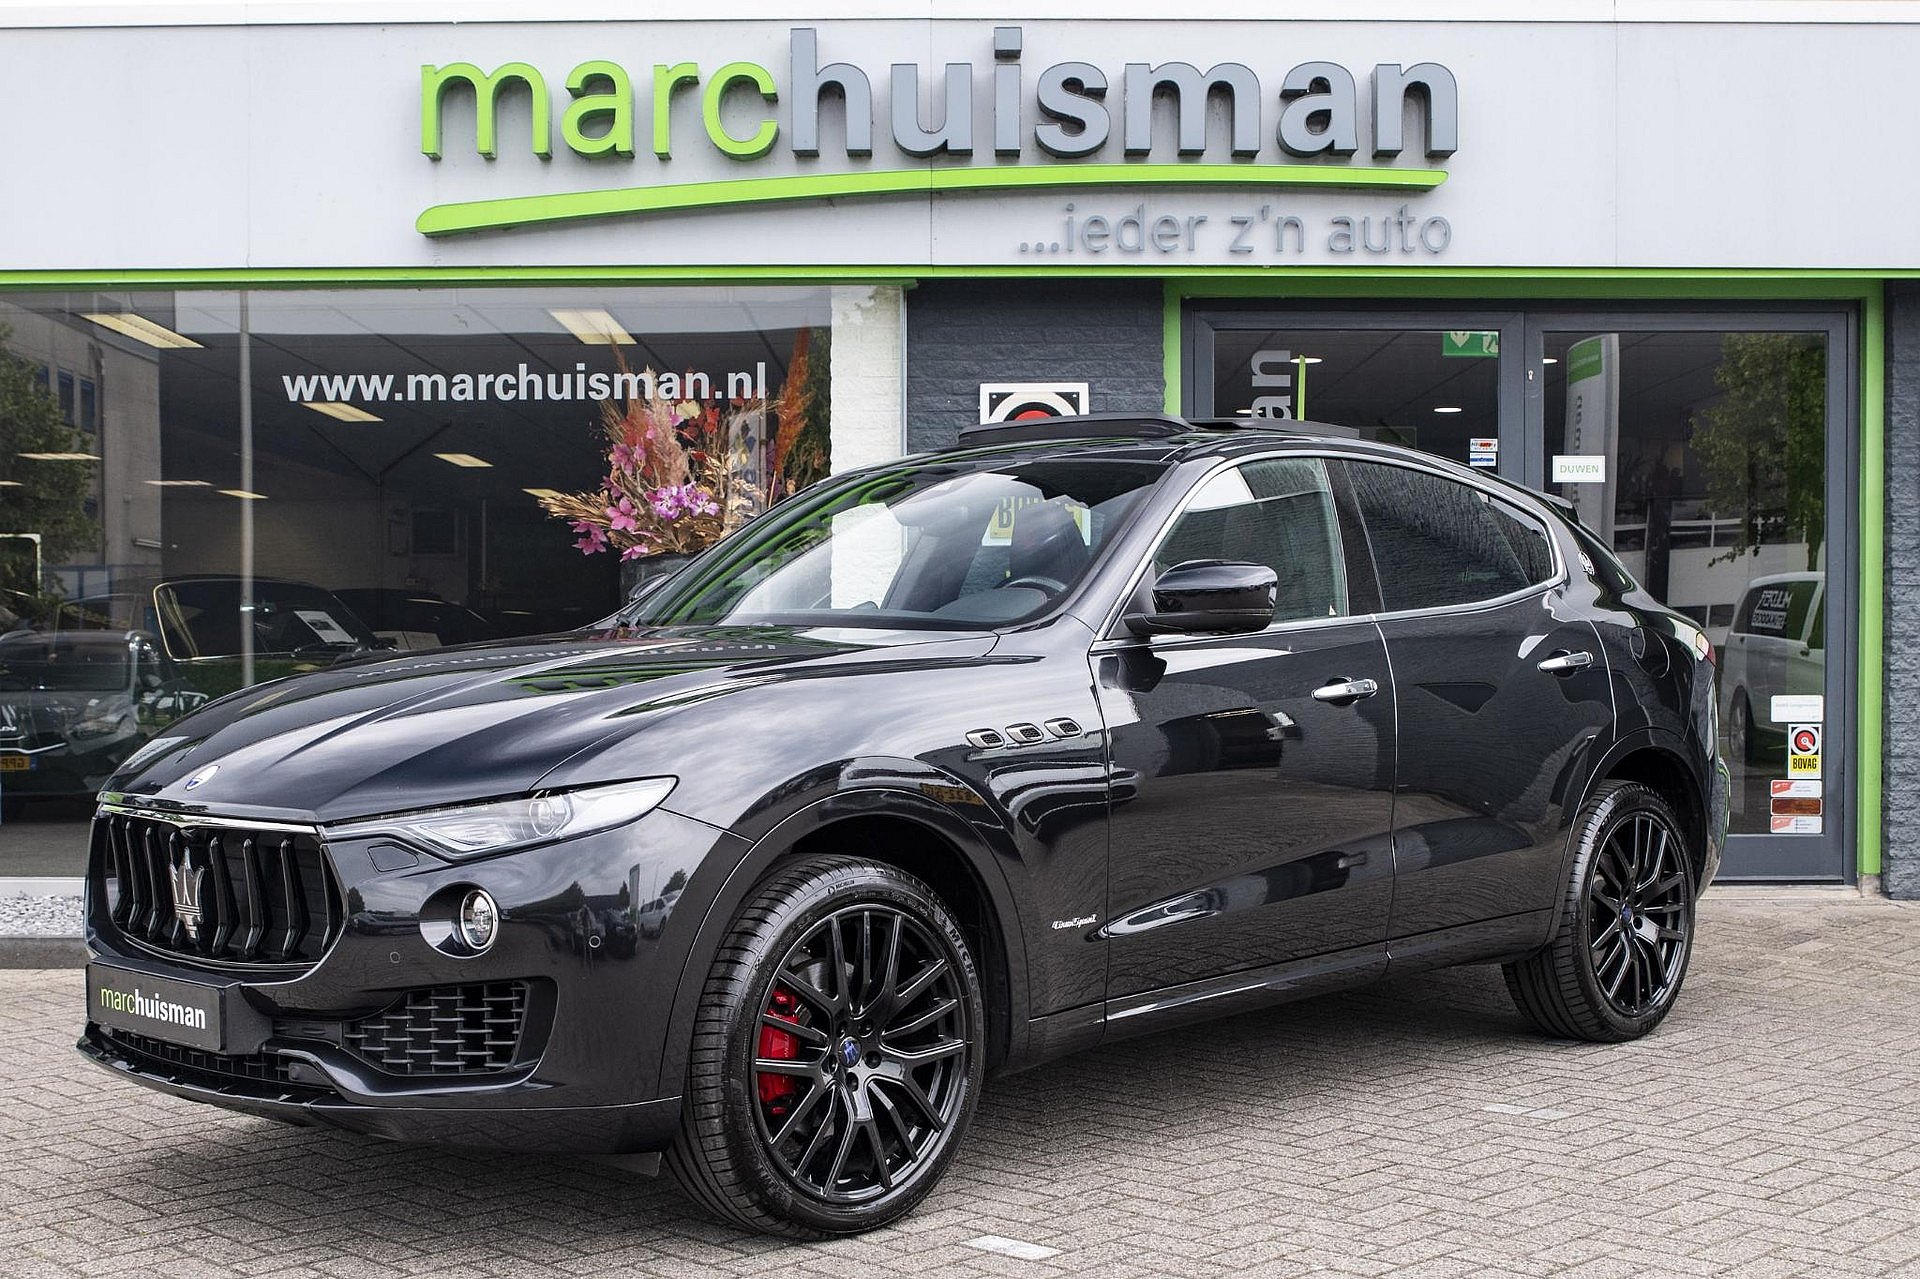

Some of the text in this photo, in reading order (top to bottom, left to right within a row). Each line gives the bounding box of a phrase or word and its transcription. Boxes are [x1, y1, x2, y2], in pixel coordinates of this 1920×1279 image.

[1229, 204, 1305, 253] z'n
[1328, 203, 1452, 254] auto
[282, 362, 767, 402] www.marchuisman.nl
[1559, 464, 1600, 474] DUWEN
[1792, 757, 1817, 770] BOVAG
[100, 988, 206, 1029] marchuisman
